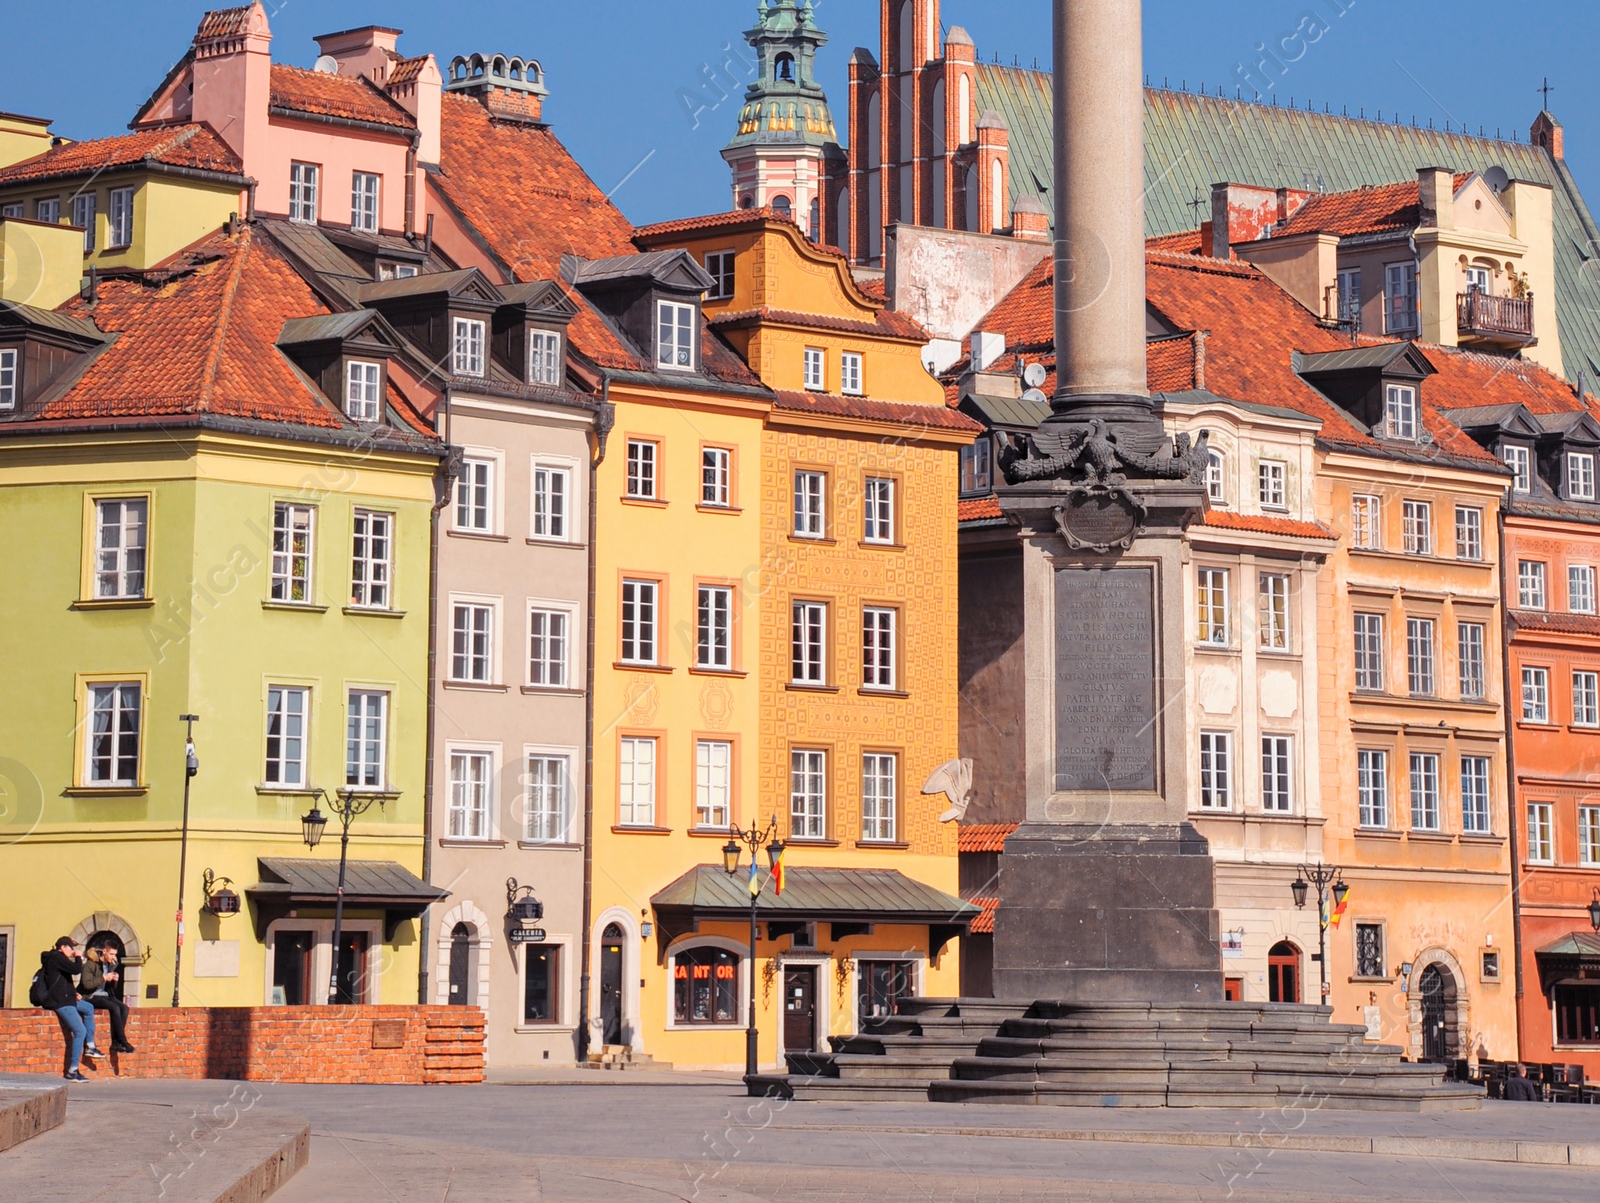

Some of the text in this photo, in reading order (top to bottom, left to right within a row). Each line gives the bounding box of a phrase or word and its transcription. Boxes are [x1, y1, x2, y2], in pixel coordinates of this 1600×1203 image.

[1083, 591, 1122, 599] SACRAM
[1059, 611, 1147, 620] SIGISMVNDO III
[1057, 633, 1149, 641] NATVRA AMORE GENIO
[1085, 644, 1121, 652] FILIVS
[1076, 662, 1131, 670] SVCCESSOR
[1083, 683, 1125, 691] GRATVS
[1066, 694, 1141, 703] PATRI PATRIAE
[1063, 705, 1098, 713] PARENTI
[1064, 747, 1096, 755] GLORIA
[1117, 773, 1145, 781] DEBET
